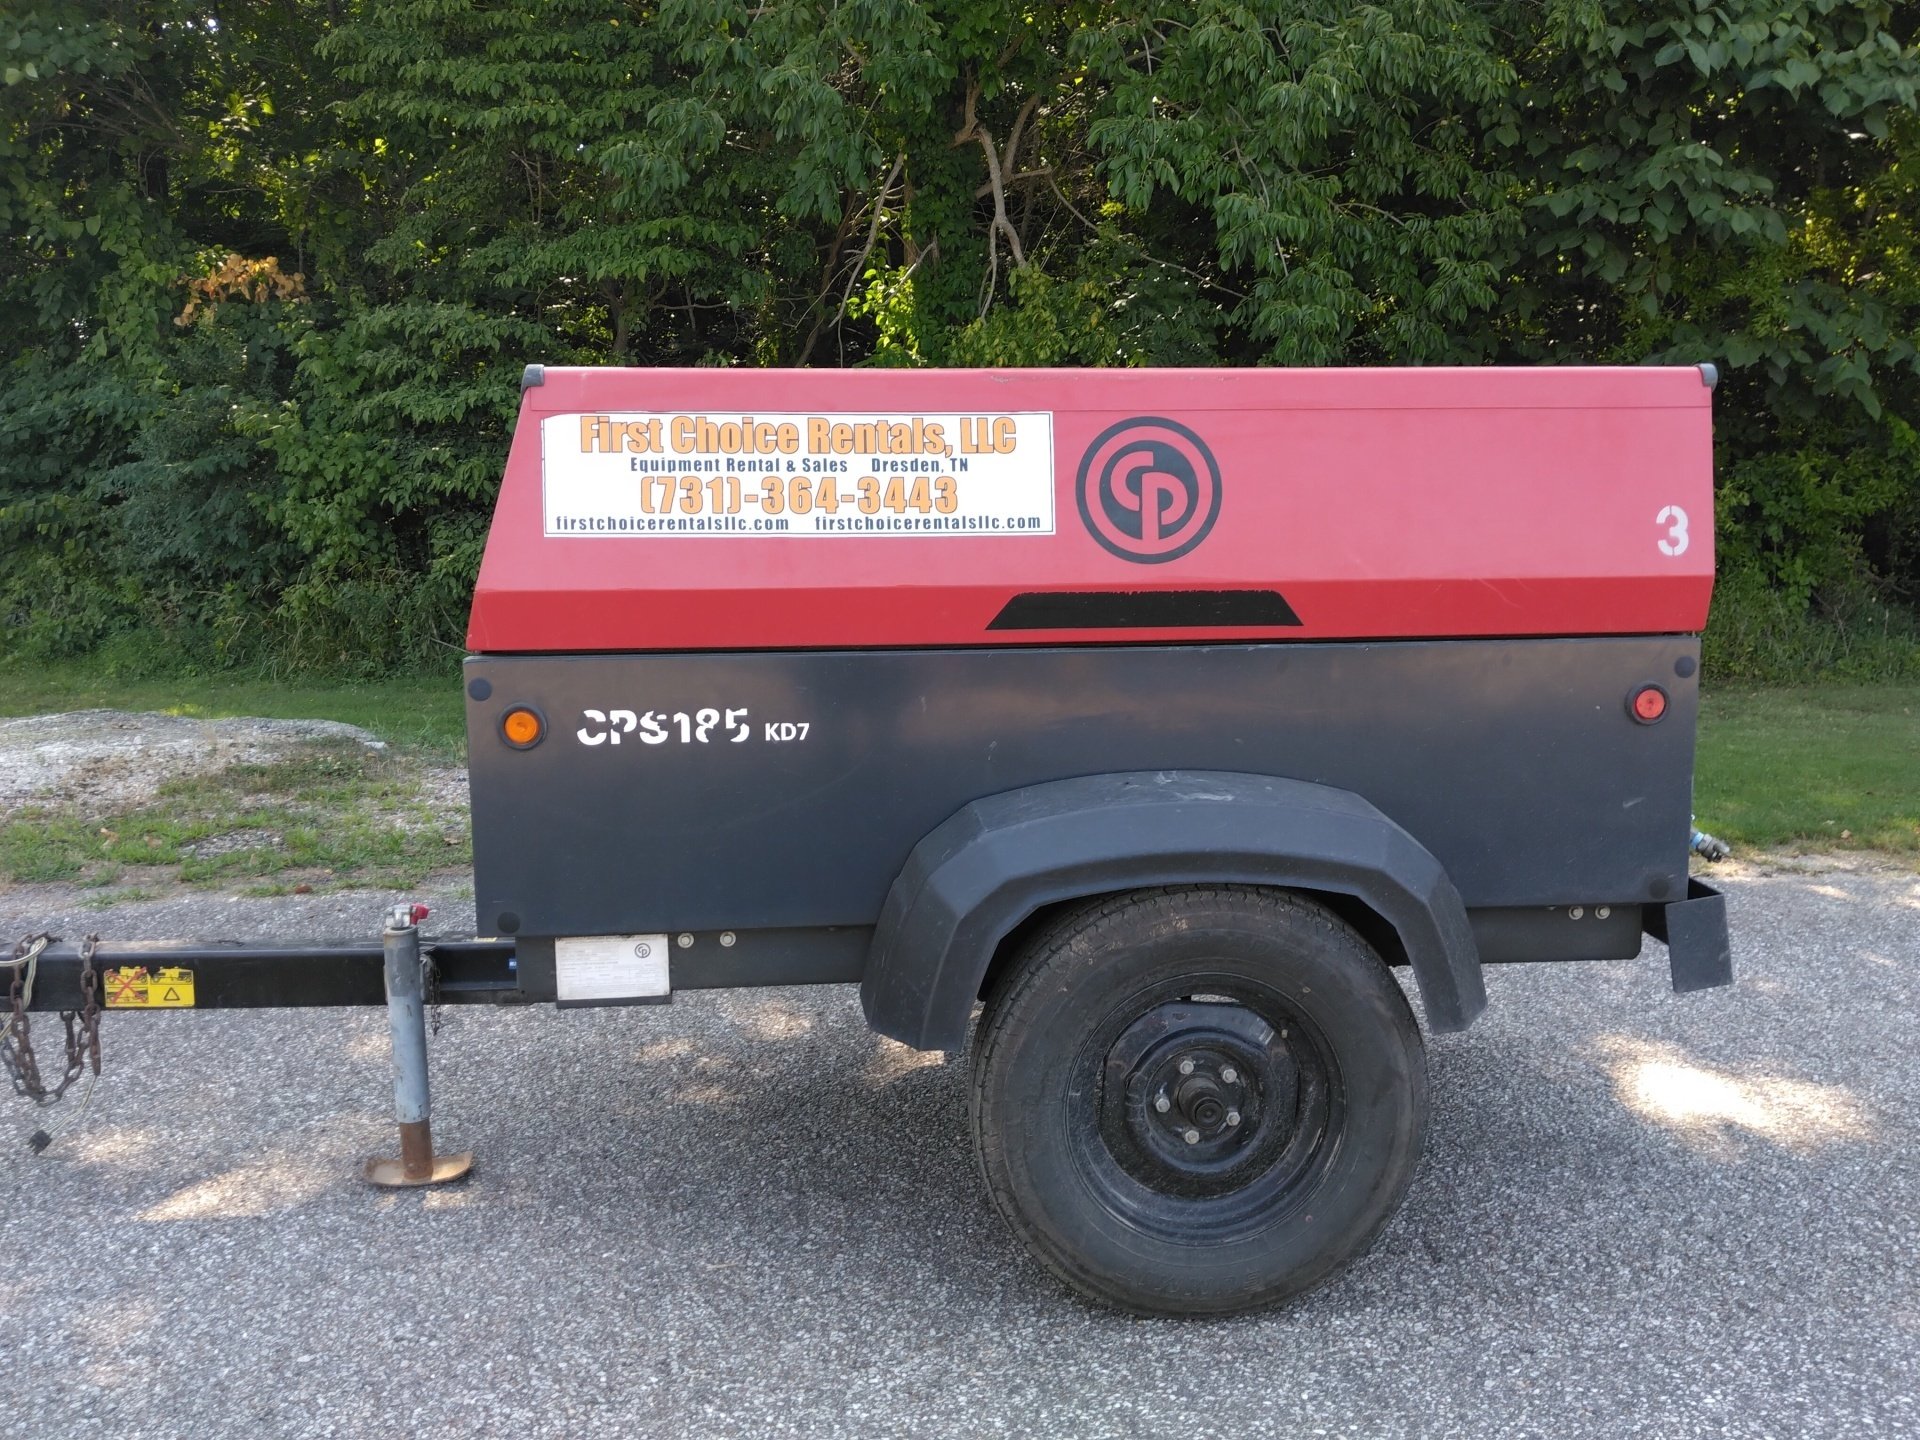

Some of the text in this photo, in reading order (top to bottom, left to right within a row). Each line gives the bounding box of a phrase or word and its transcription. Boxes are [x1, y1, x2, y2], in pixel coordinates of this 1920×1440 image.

[580, 415, 1016, 458] First Choice Rentals, LLC
[630, 457, 968, 473] Equipment Rental & Sales Dresden, TN
[640, 476, 958, 514] (731)-364-3443
[556, 516, 1041, 531] firstchoicerentalsllc.com firstchoicerentalsllc.com
[1655, 505, 1689, 556] 3
[764, 722, 810, 742] KD7
